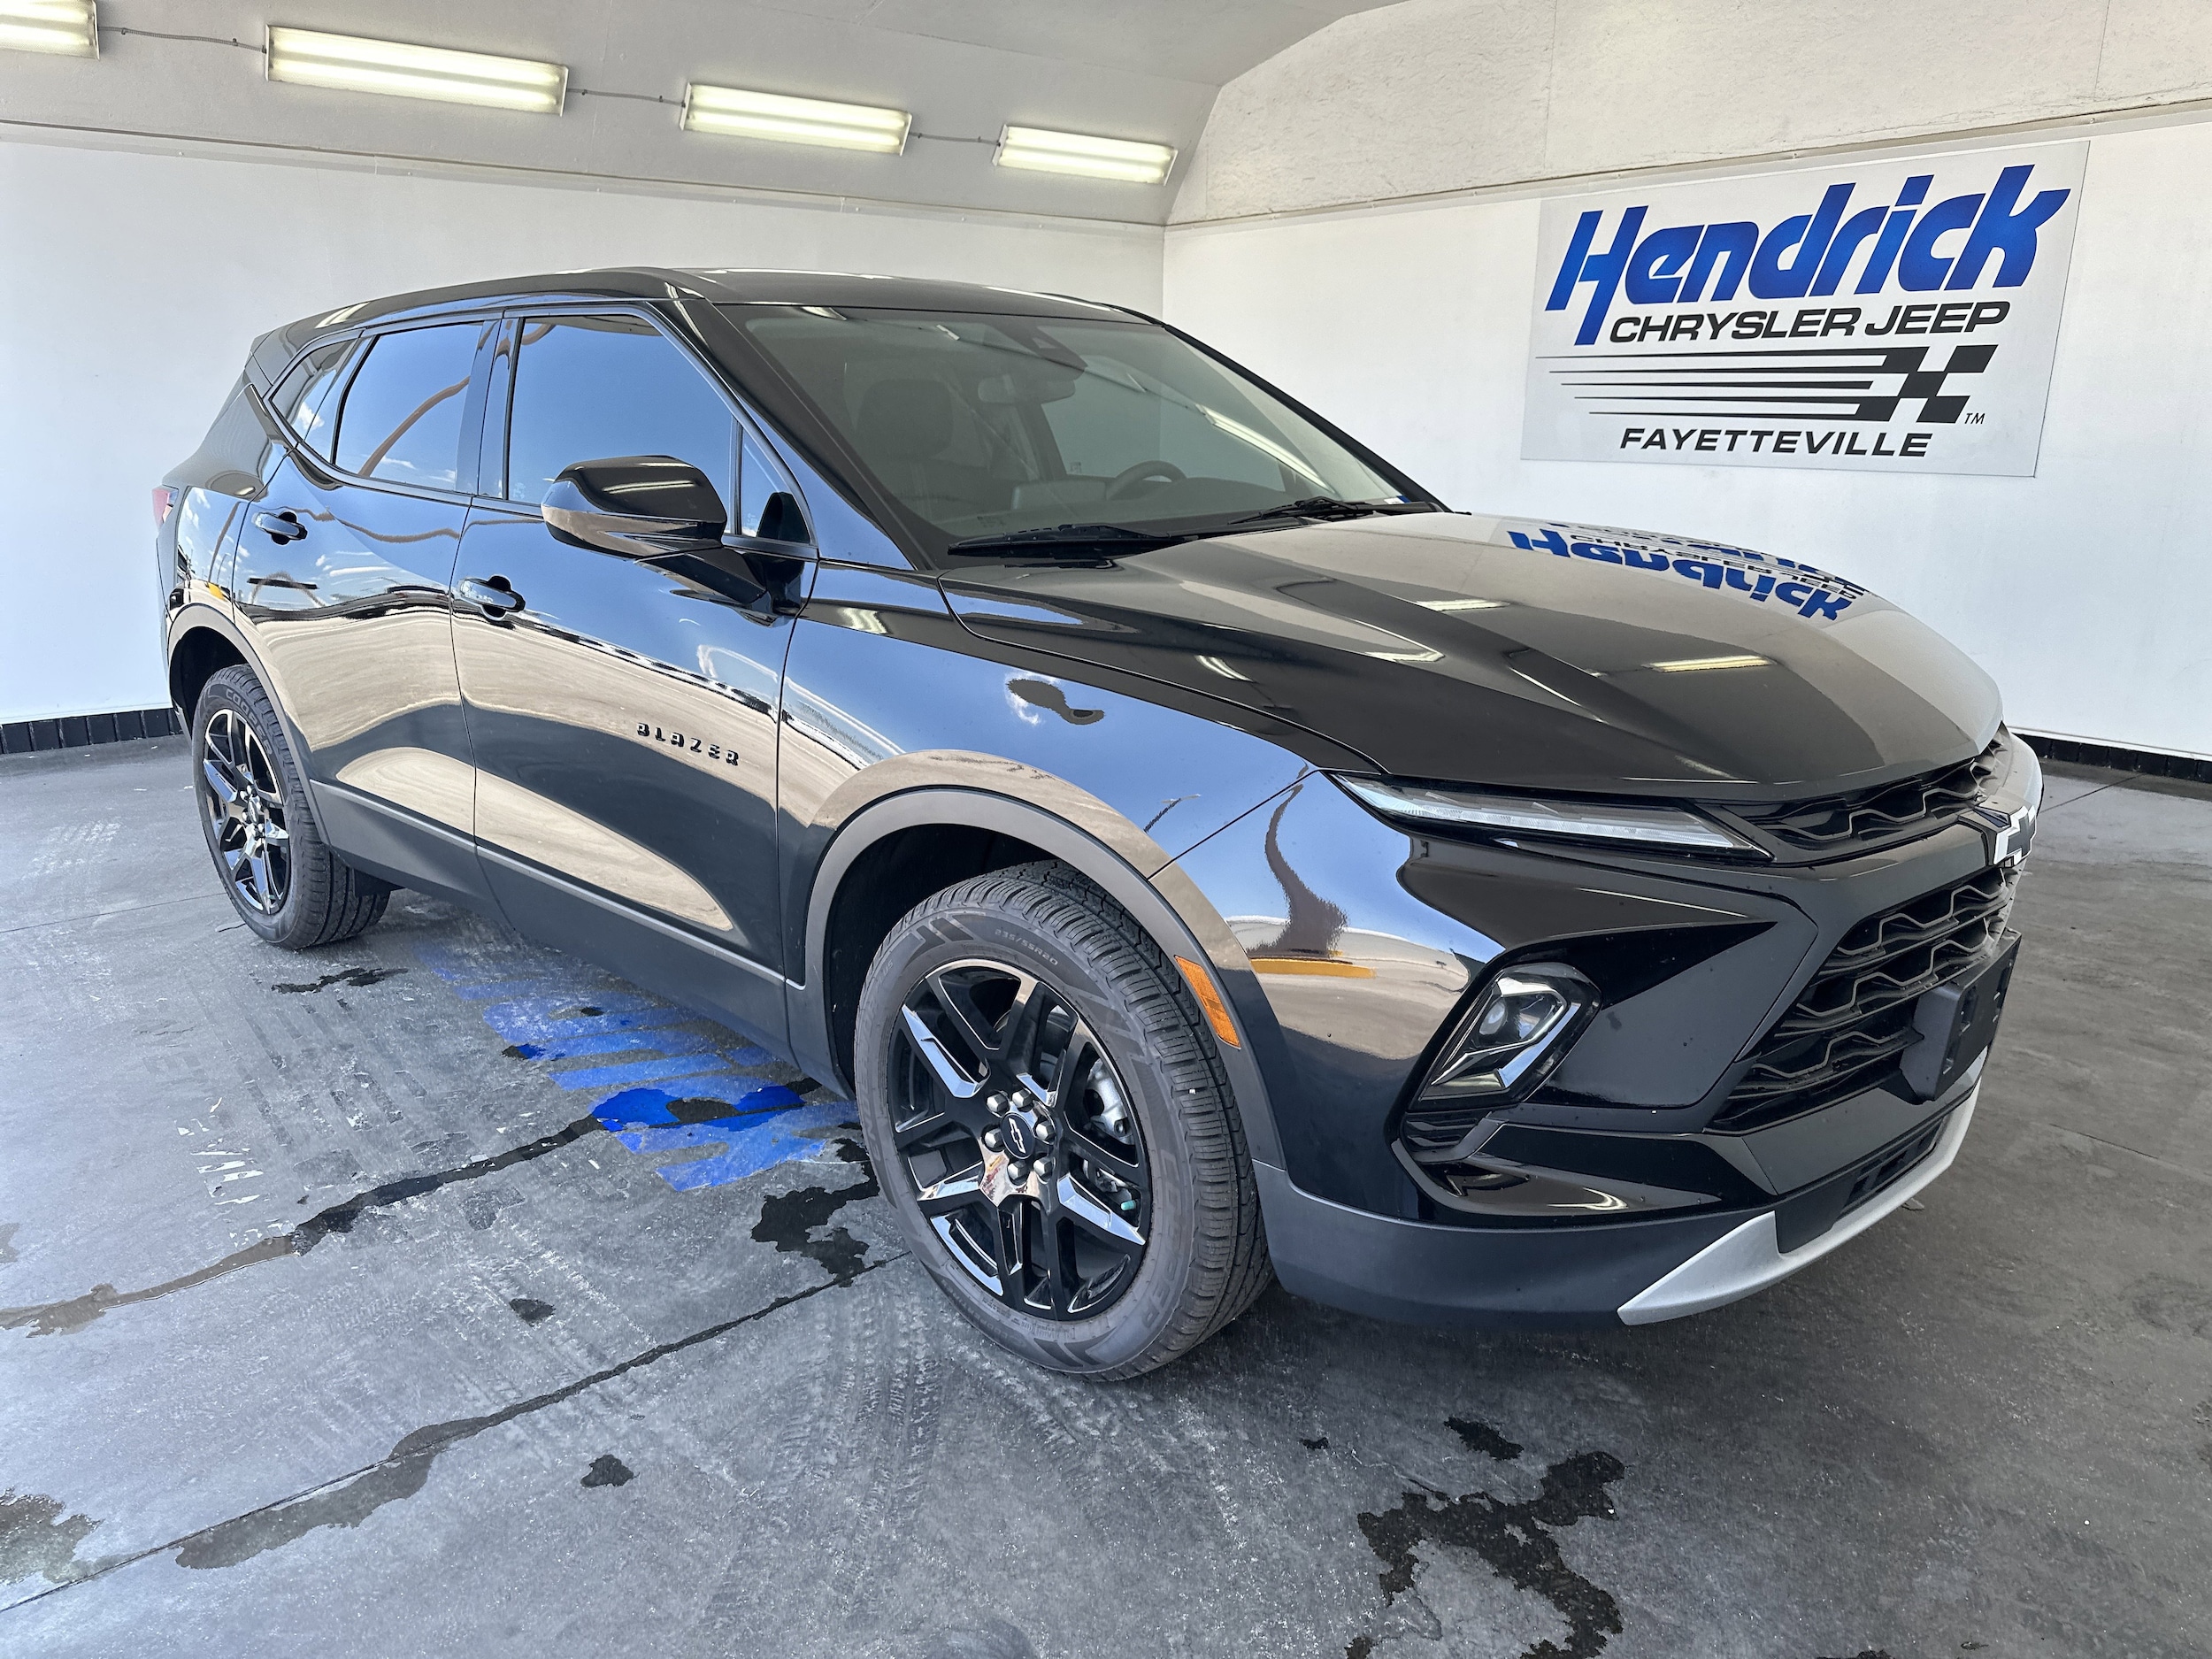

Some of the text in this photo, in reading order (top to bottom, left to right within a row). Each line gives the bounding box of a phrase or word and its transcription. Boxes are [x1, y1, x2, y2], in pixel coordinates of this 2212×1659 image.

[1545, 164, 2071, 346] Hendrick
[1609, 301, 2010, 343] CHRYSLER JEEP
[1965, 412, 1985, 425] TM
[1620, 427, 1932, 457] FAYETTEVILLE
[226, 688, 274, 755] COOPER
[637, 723, 739, 766] BLAZER
[995, 928, 1058, 966] 235/55R20
